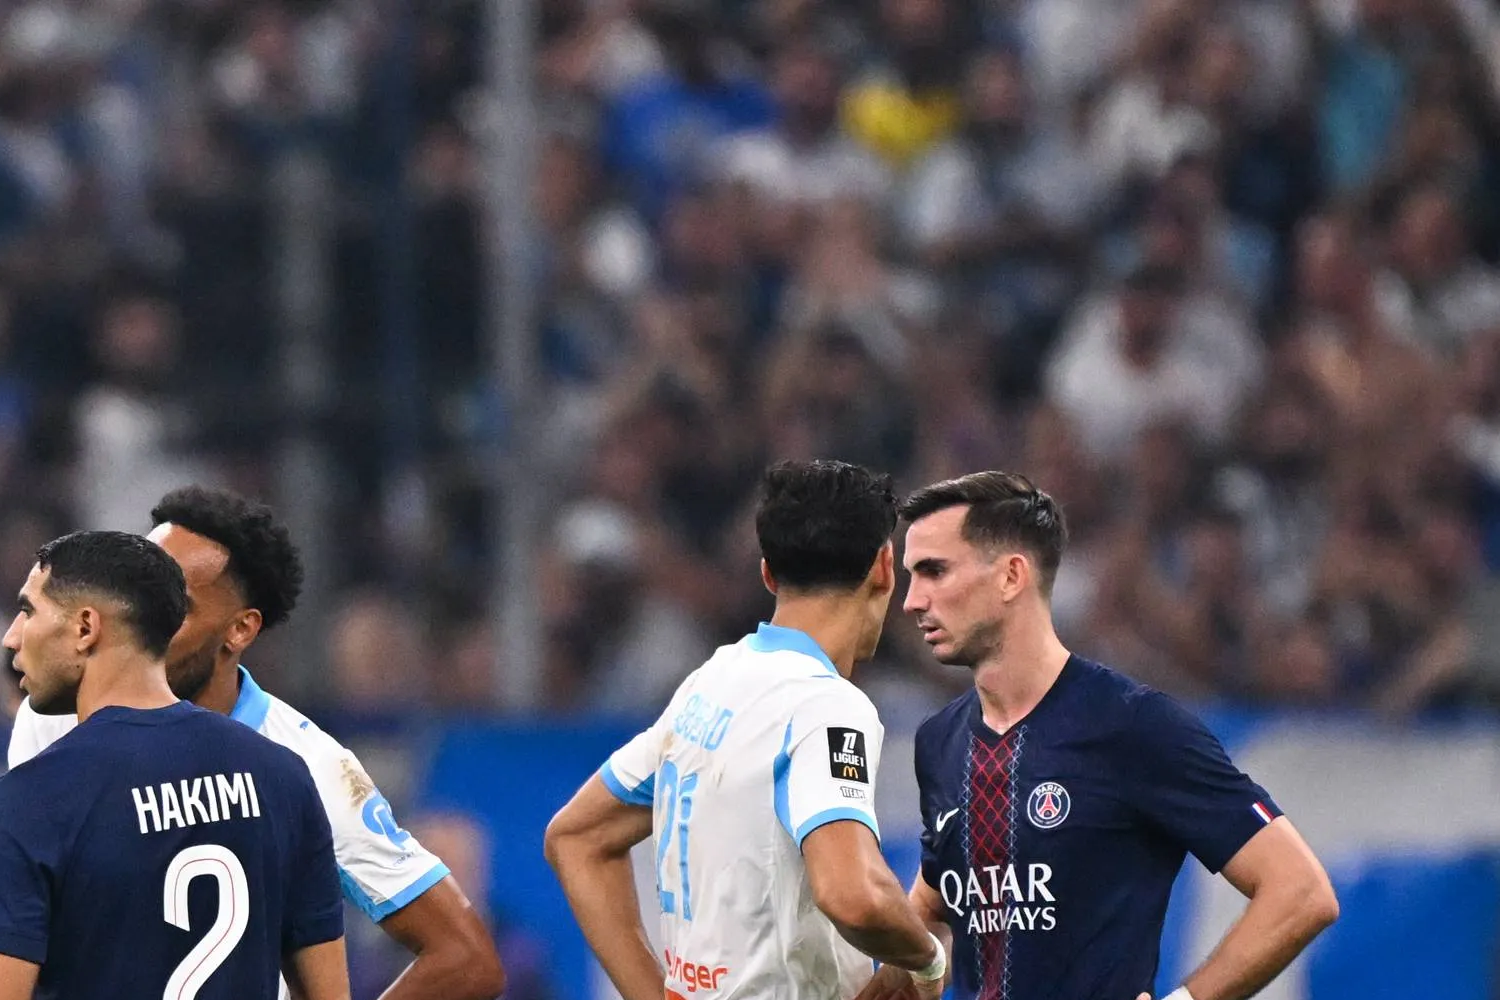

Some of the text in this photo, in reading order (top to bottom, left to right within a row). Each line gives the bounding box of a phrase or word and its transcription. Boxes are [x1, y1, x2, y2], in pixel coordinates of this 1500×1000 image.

[833, 752, 860, 766] LIGUE
[132, 772, 261, 834] HAKIMI
[1035, 785, 1063, 797] PARIS
[940, 863, 1056, 917] QATAR
[968, 906, 1056, 935] AIRWAYS
